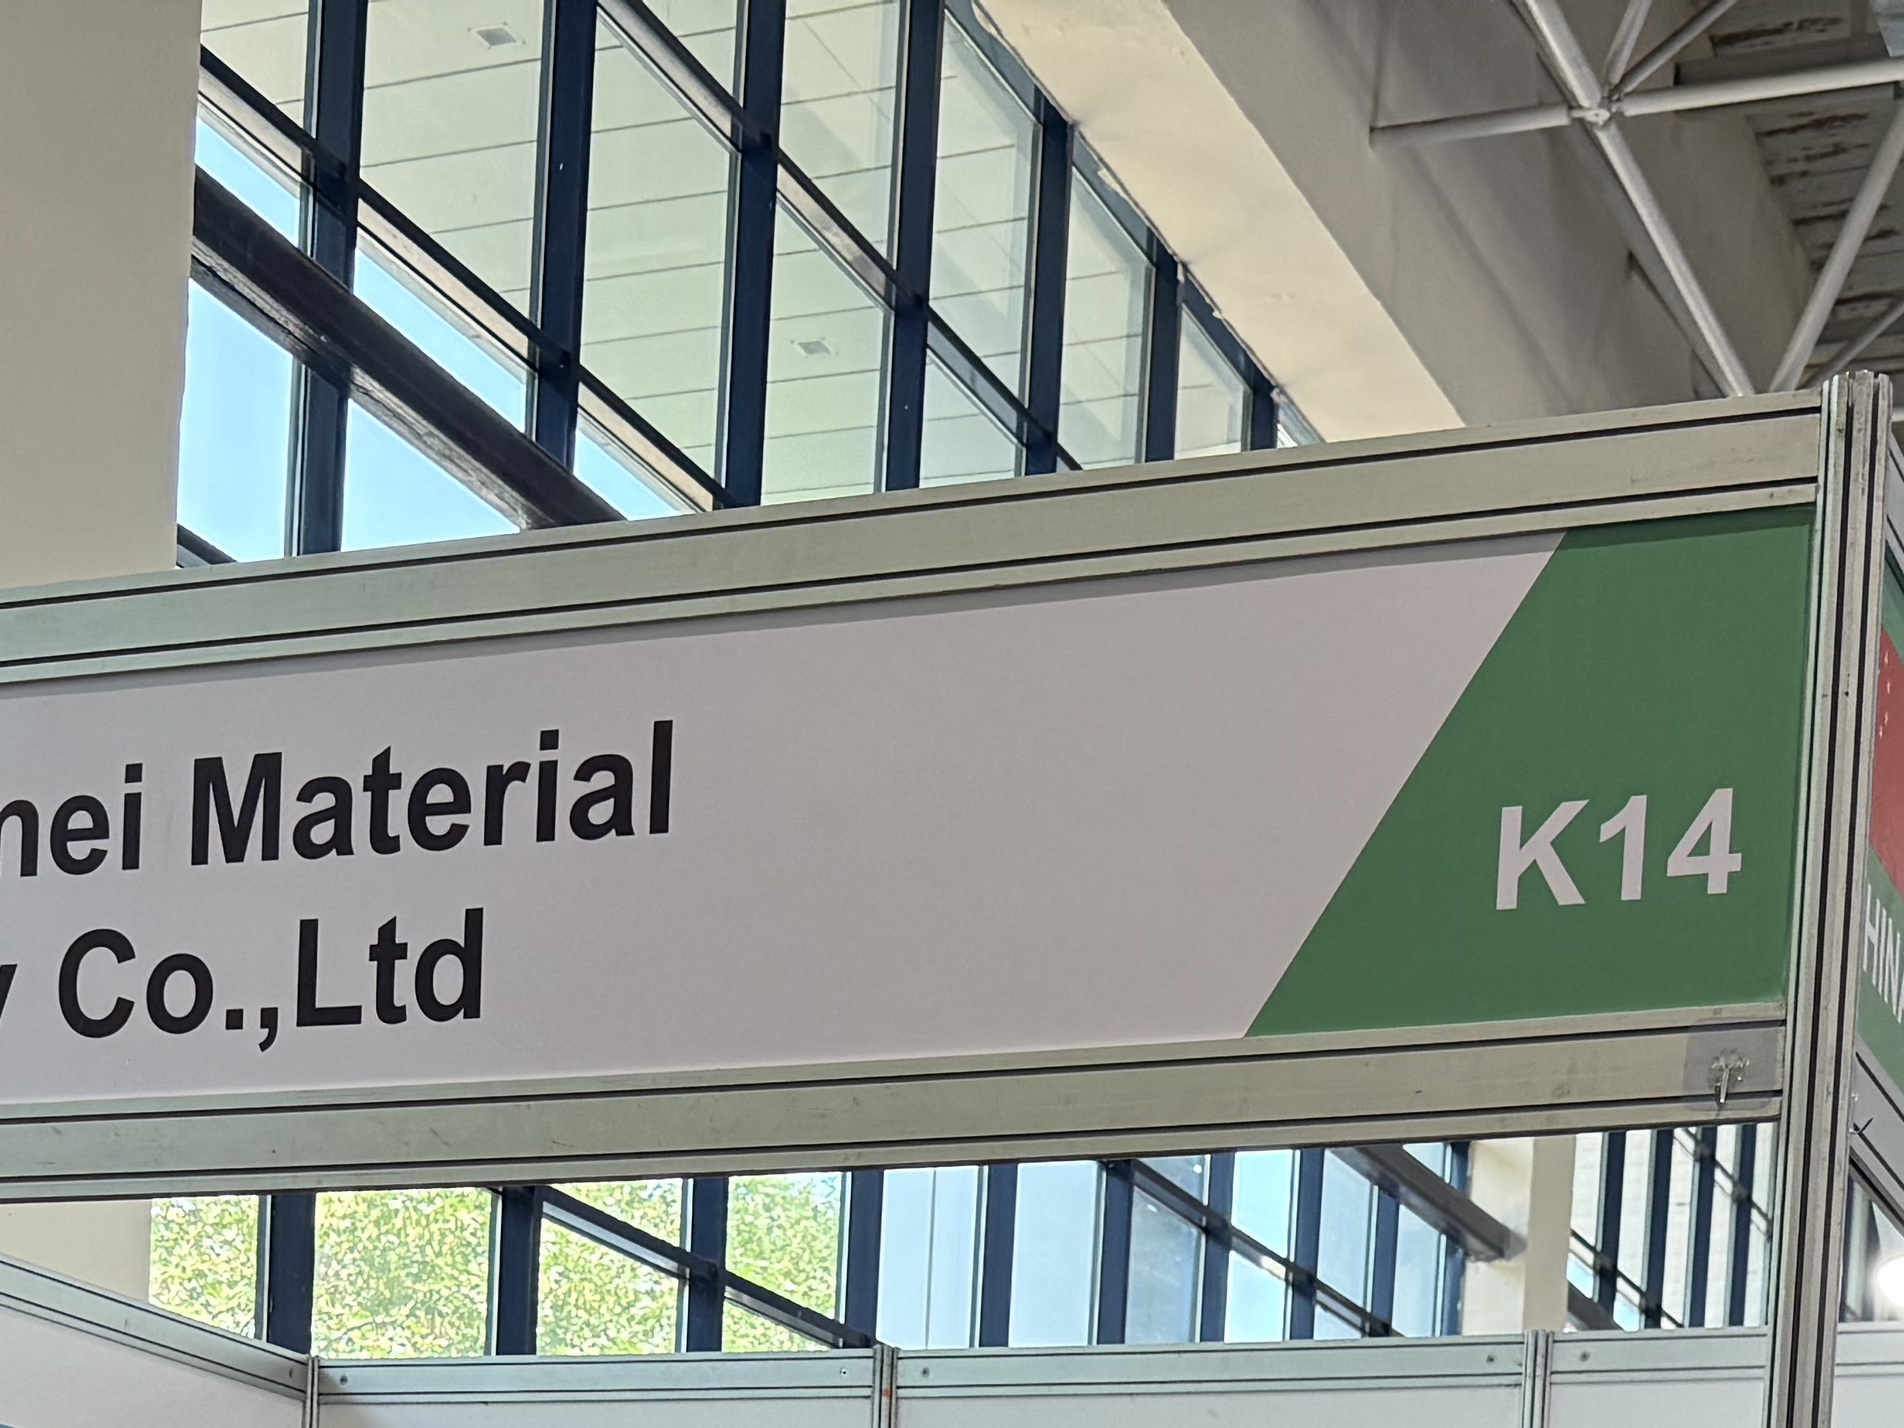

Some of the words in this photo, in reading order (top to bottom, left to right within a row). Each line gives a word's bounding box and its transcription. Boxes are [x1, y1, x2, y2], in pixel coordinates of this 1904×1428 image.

[188, 719, 675, 866] Material
[1496, 788, 1742, 910] K14
[56, 907, 485, 1051] Co.,Ltd
